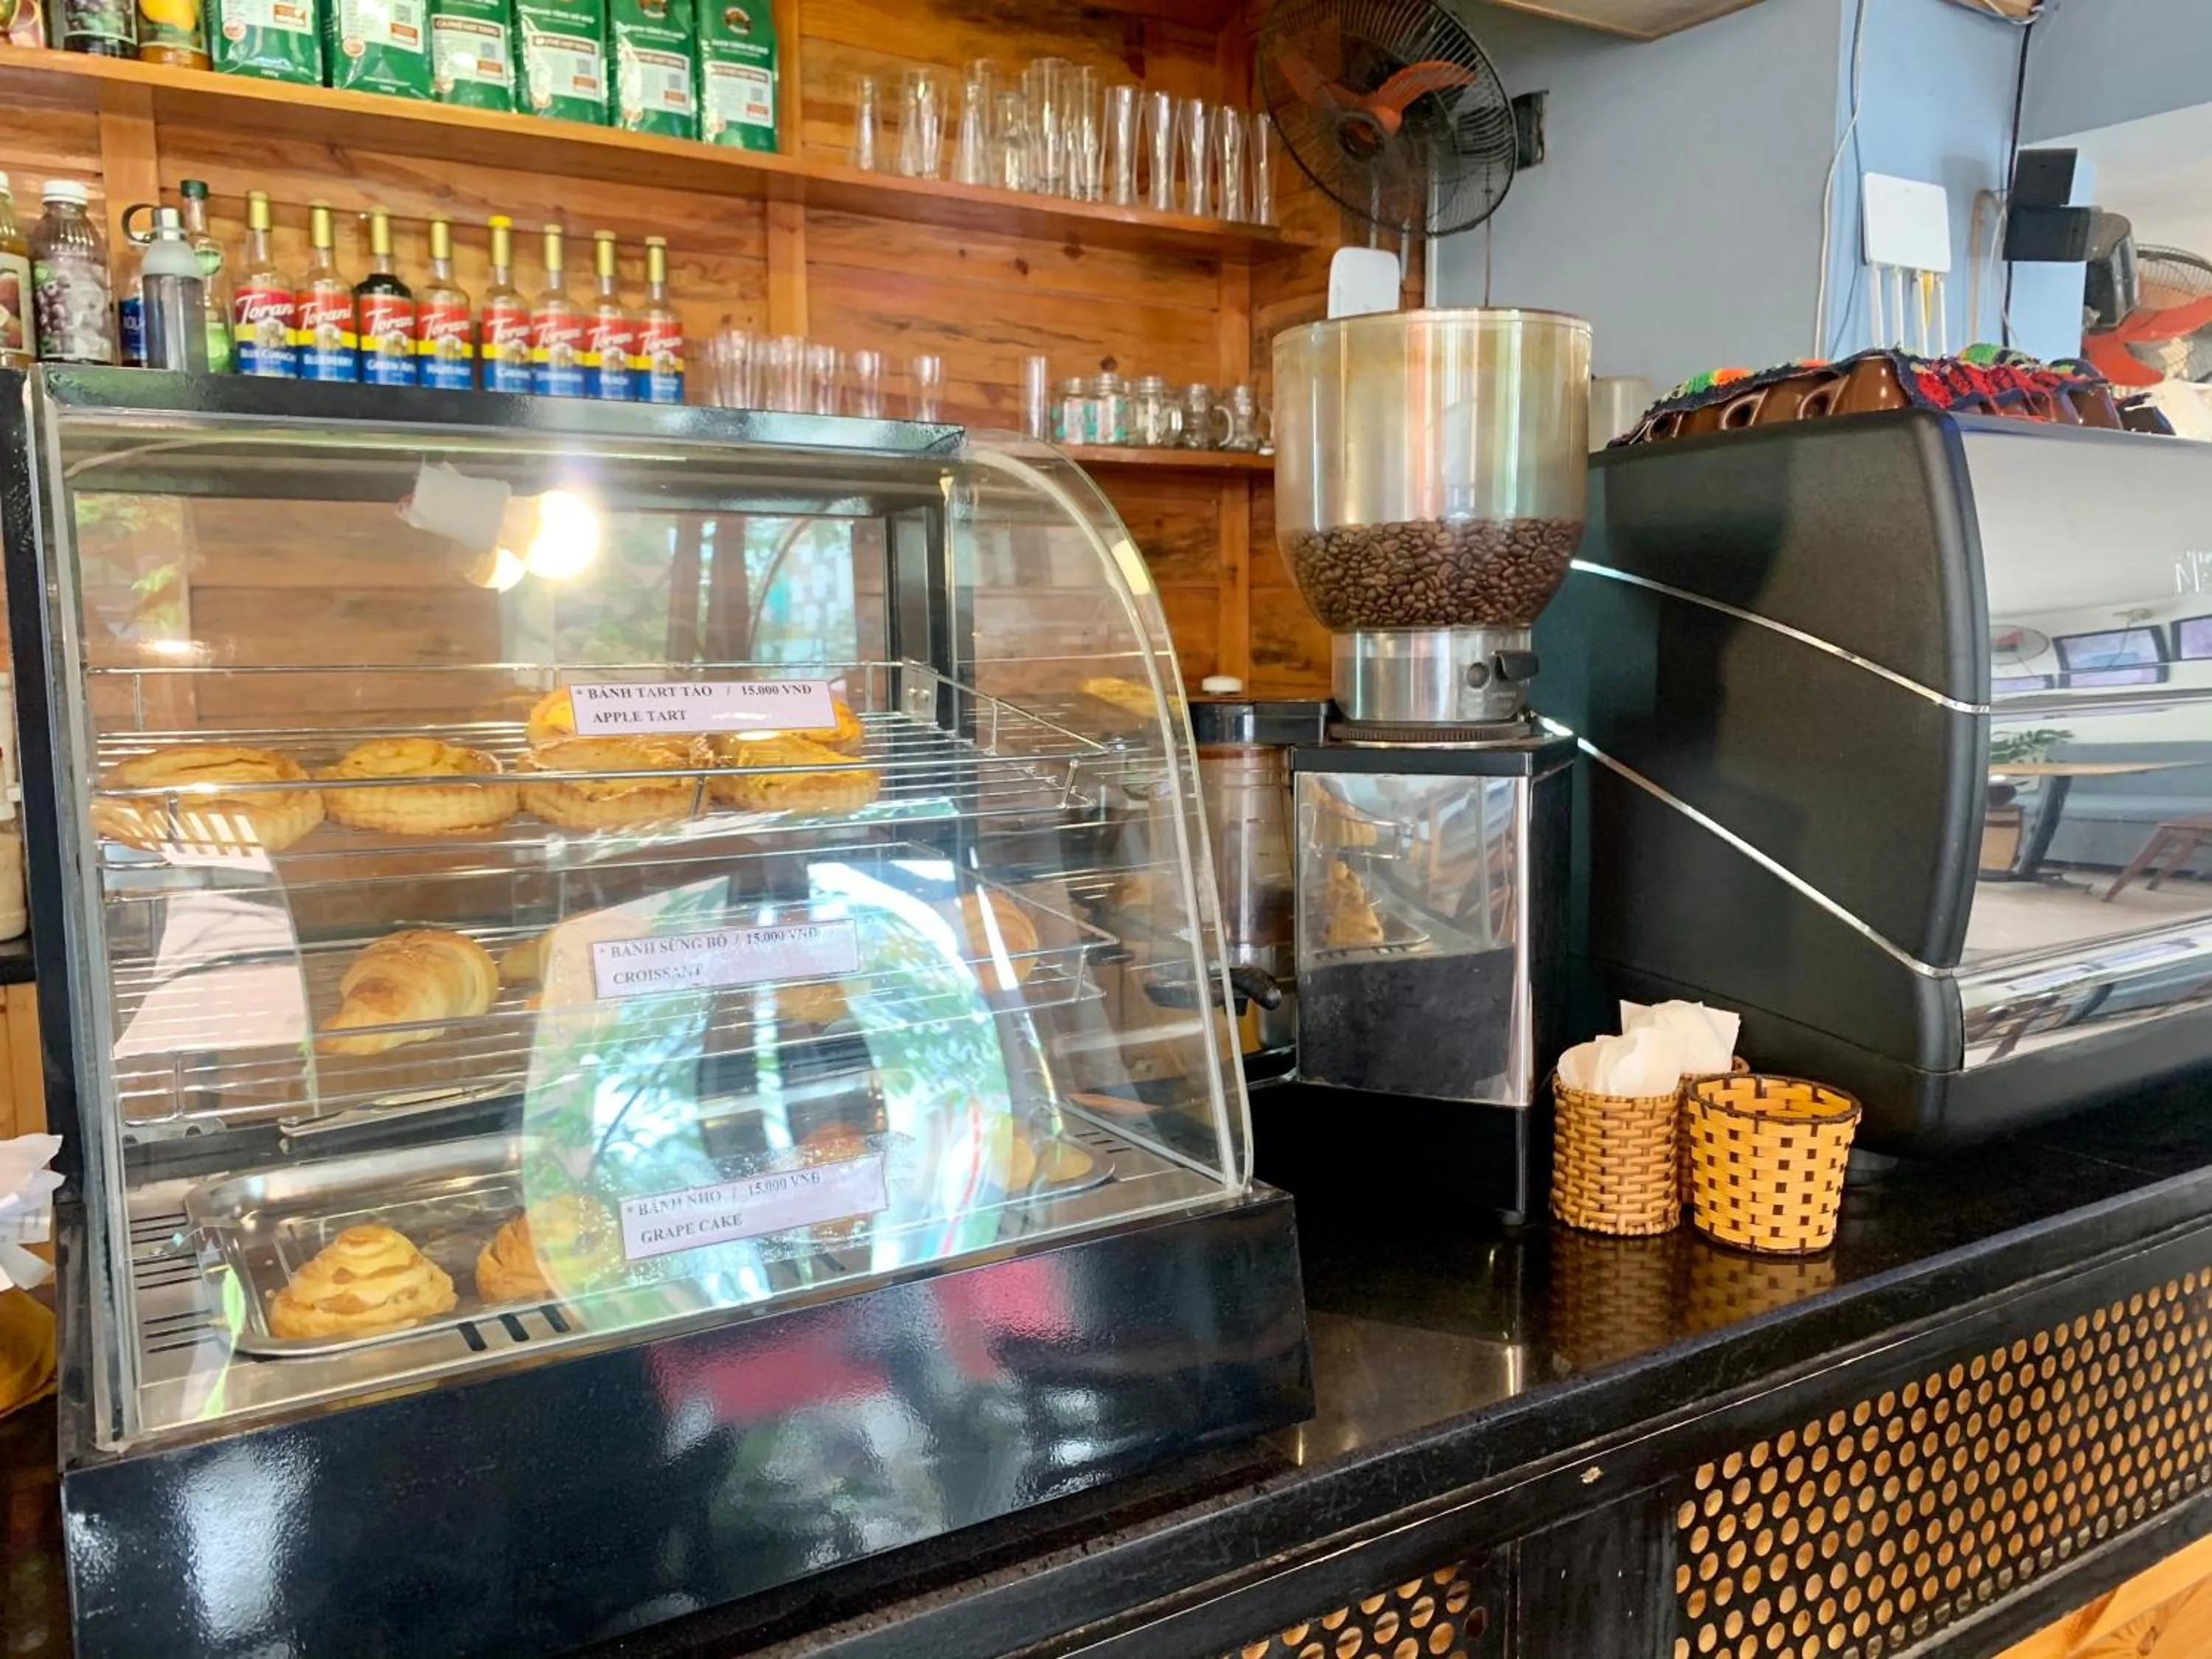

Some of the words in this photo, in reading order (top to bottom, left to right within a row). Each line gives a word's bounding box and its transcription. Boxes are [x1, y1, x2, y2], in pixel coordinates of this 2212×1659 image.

[298, 301, 353, 330] Torani
[588, 686, 632, 699] BÁNH
[635, 686, 677, 698] TART
[742, 684, 779, 695] 15.000
[593, 711, 642, 723] APPLE
[645, 709, 687, 722] TART
[746, 931, 785, 945] 15.000
[748, 1178, 788, 1197] 15.000
[640, 1222, 695, 1243] GRAPE
[698, 1213, 743, 1232] CAKE
